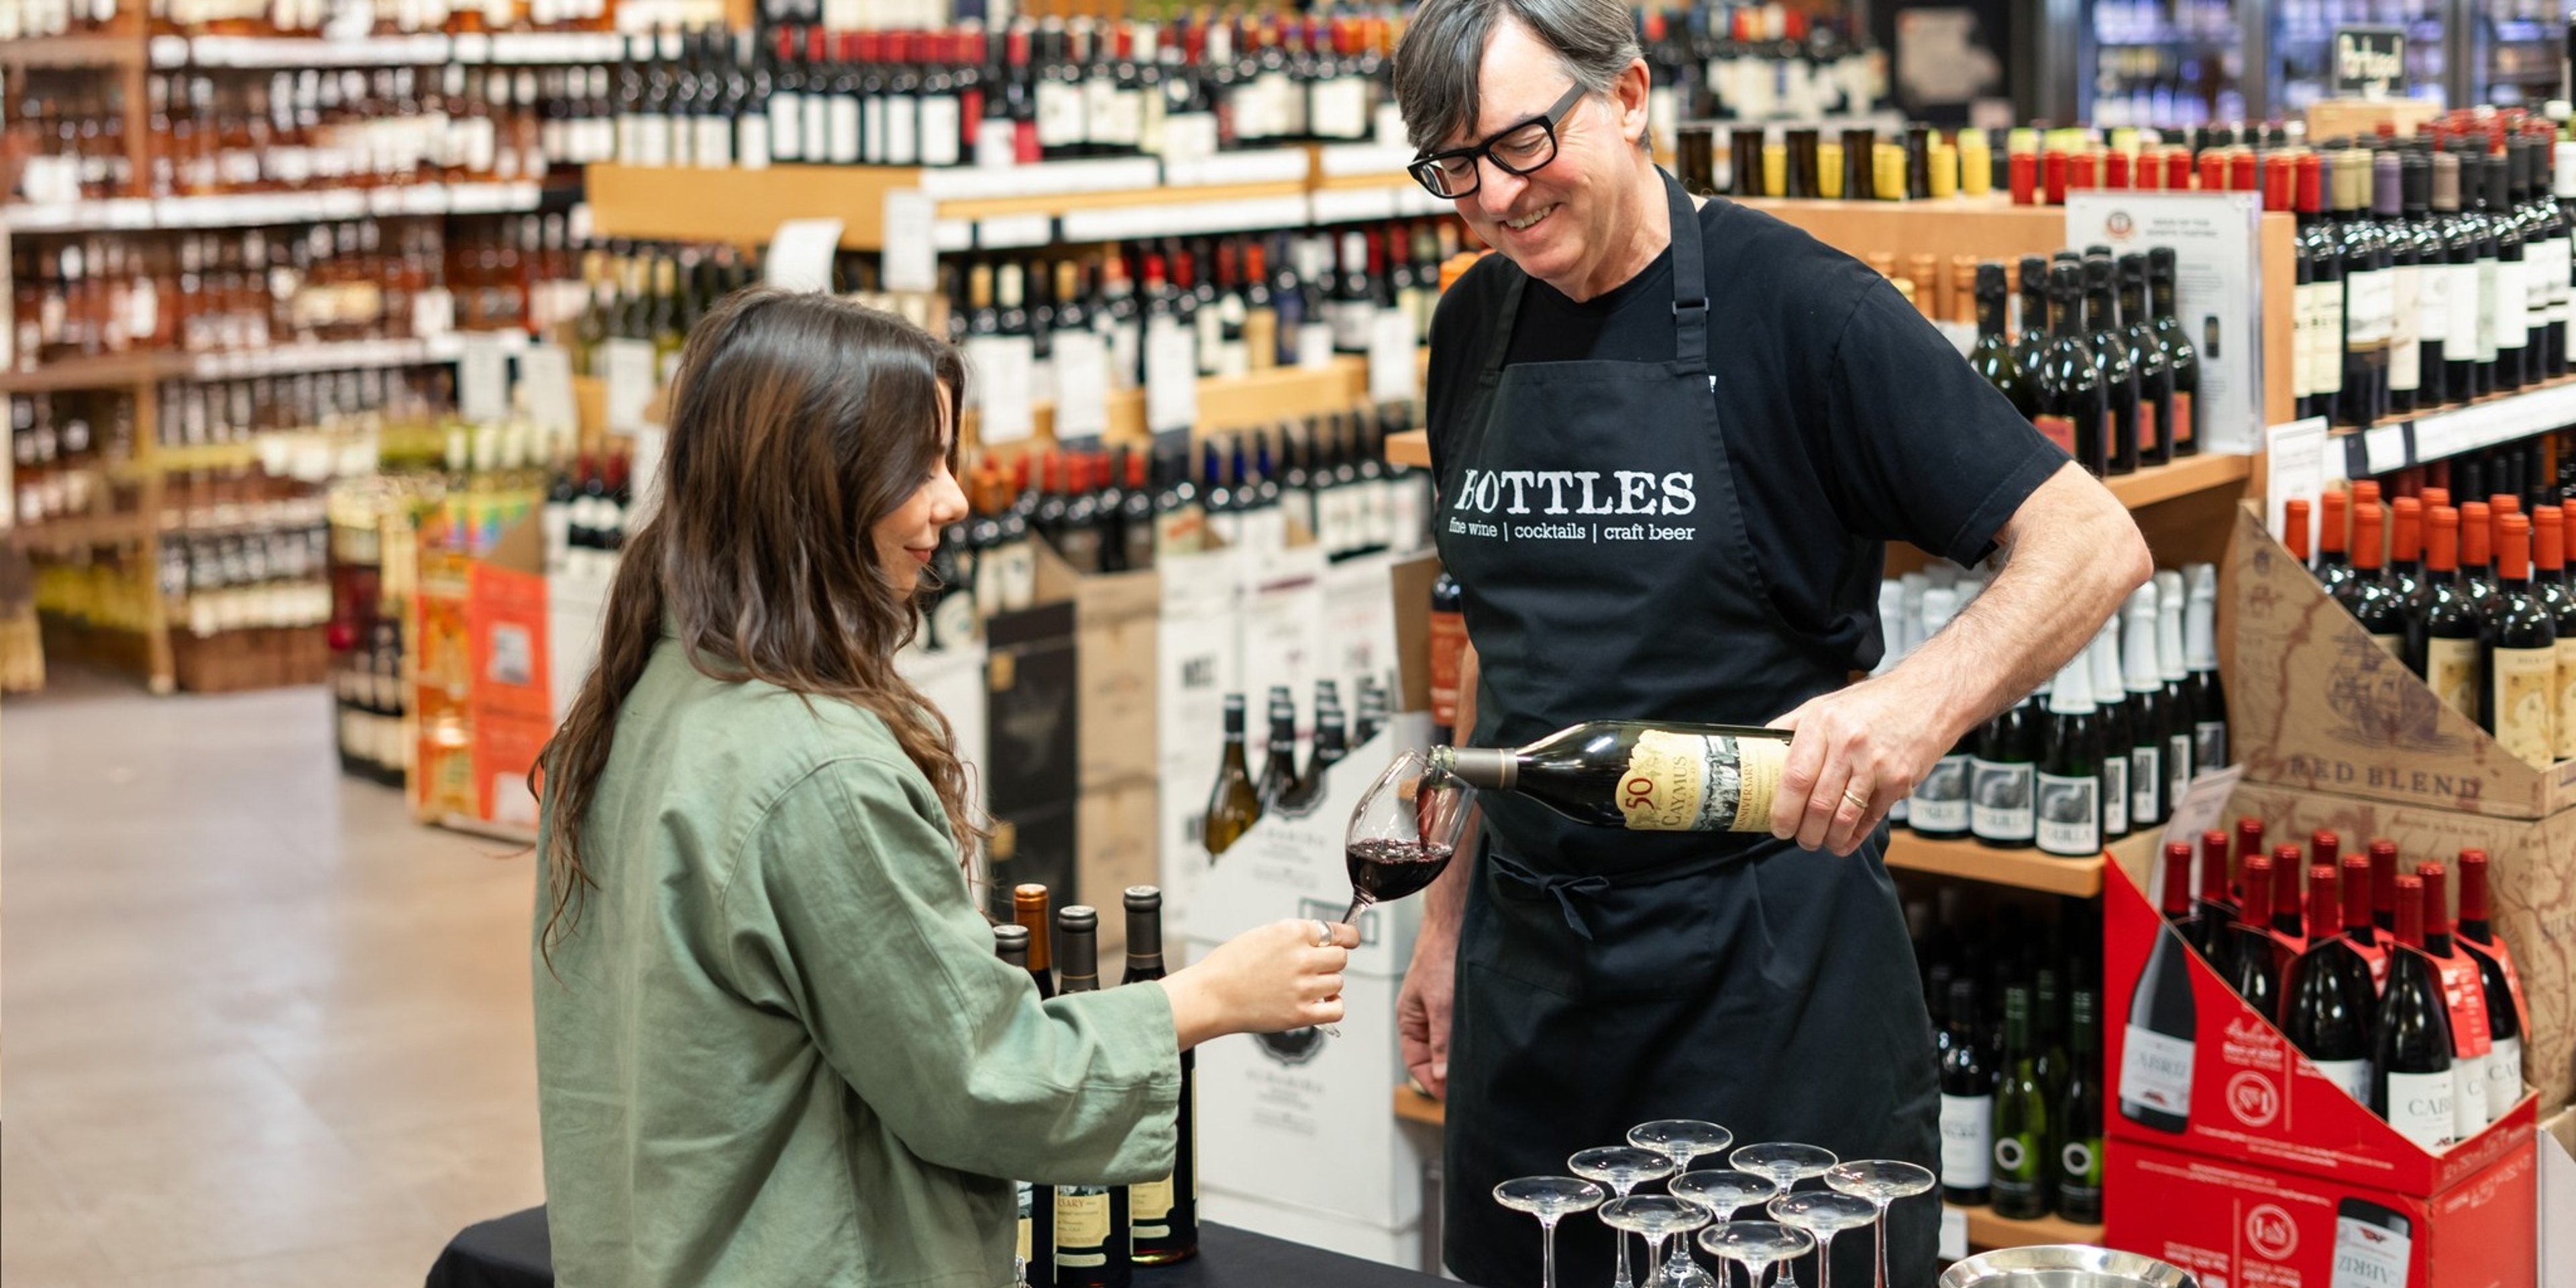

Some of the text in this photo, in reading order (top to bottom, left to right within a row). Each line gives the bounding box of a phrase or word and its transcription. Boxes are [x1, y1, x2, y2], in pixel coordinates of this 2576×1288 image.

[1454, 469, 1697, 516] BOTTLES
[1448, 517, 1696, 541] fine wine cocktails craft beer
[1625, 777, 1655, 810] 50
[1661, 755, 1688, 826] CAYMUS
[1738, 761, 1754, 828] ANNIVERSARY
[2290, 755, 2483, 800] RED BLEND
